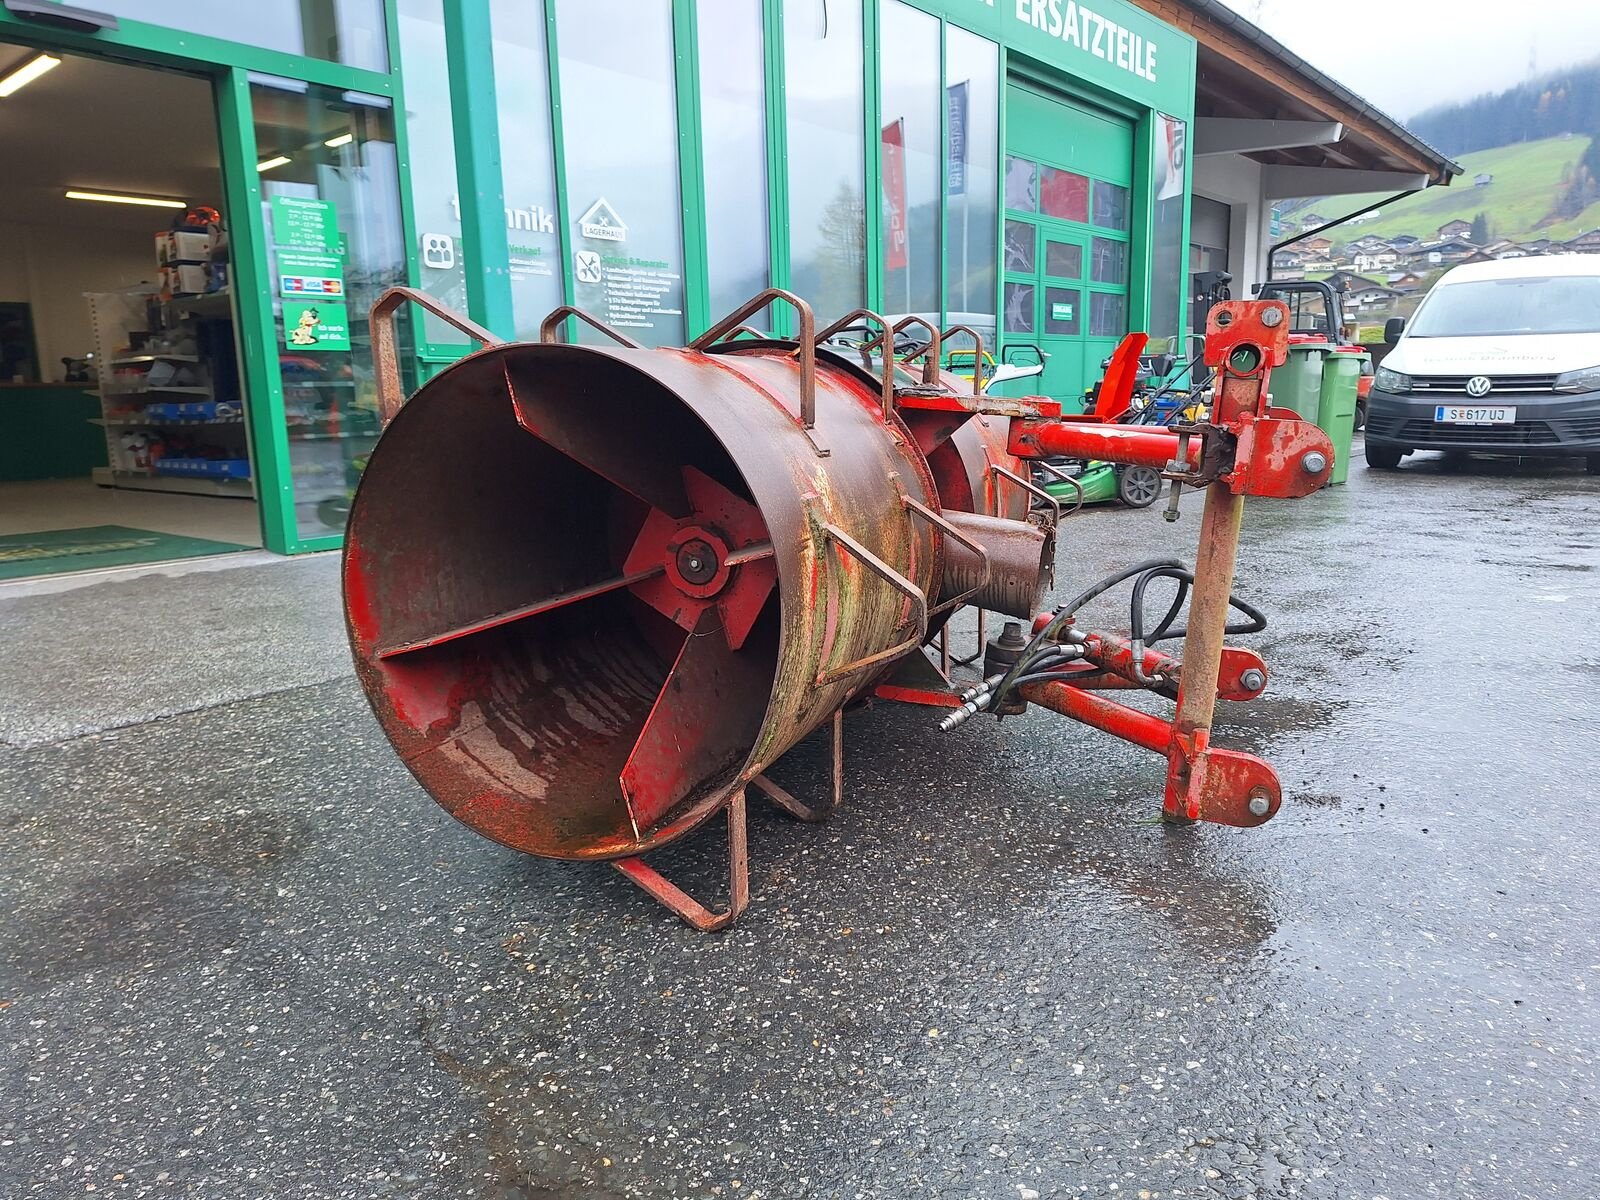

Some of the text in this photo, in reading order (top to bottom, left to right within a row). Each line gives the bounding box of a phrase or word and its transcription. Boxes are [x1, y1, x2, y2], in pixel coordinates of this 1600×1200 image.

[1015, 0, 1157, 83] ERSATZTEILE
[584, 227, 623, 238] LAGERHAUS
[1466, 409, 1487, 420] 617
